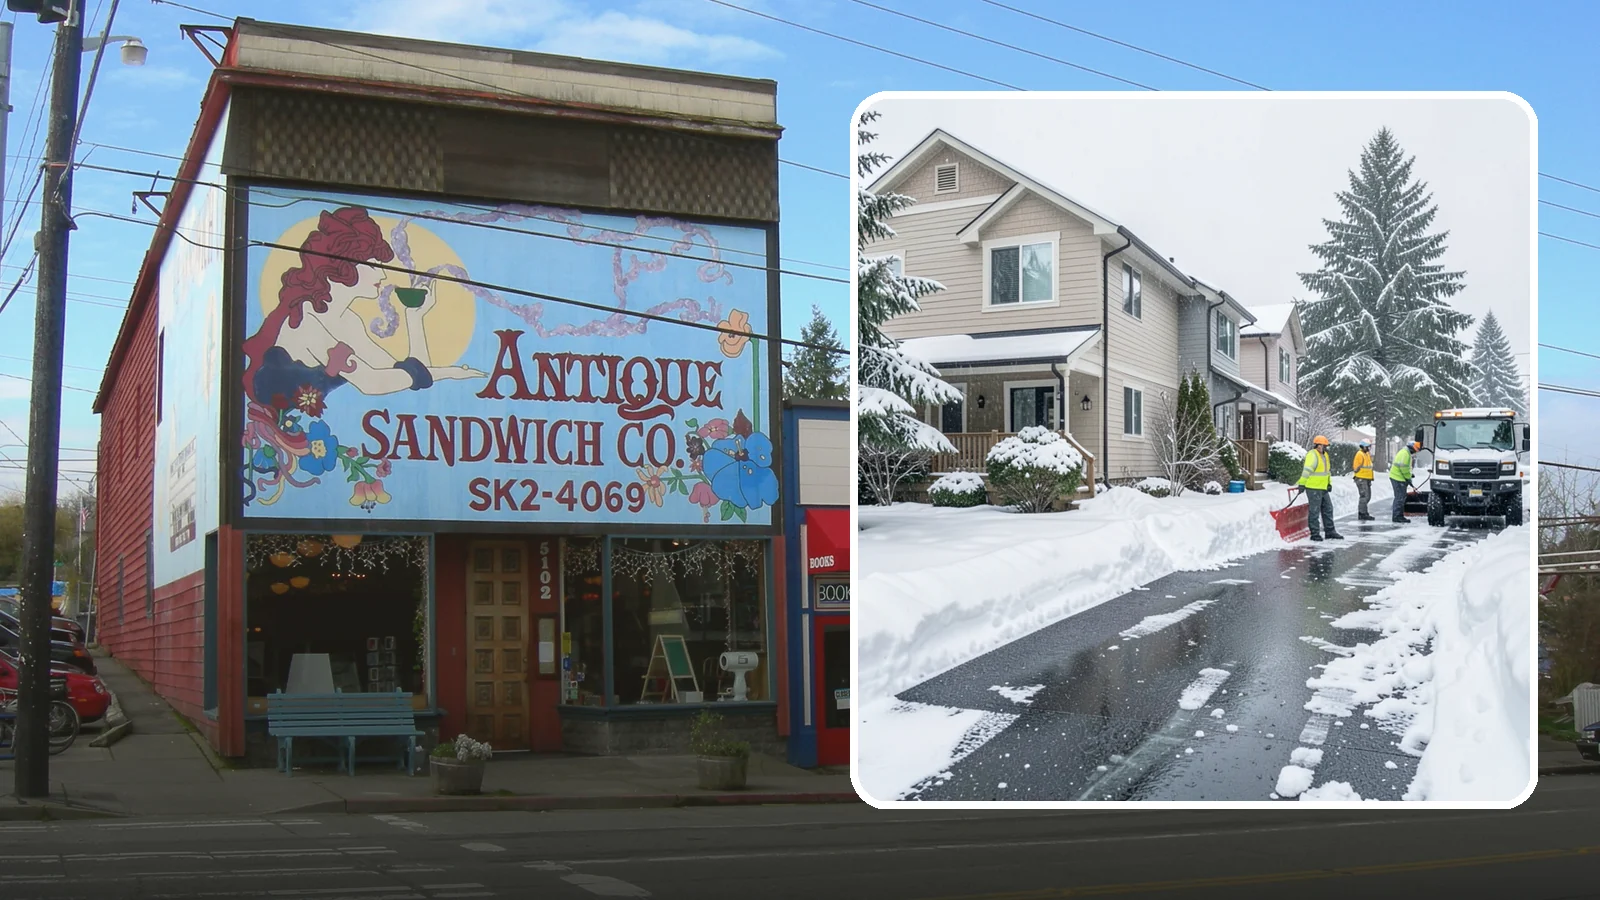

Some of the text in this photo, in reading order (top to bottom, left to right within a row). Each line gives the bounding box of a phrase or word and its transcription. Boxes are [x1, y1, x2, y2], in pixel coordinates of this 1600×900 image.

[476, 330, 723, 420] ANTIQUE
[362, 409, 685, 469] SANDWICH CO.
[468, 477, 646, 512] SK2-4069
[539, 541, 552, 600] 5102
[809, 555, 835, 569] BOOKS
